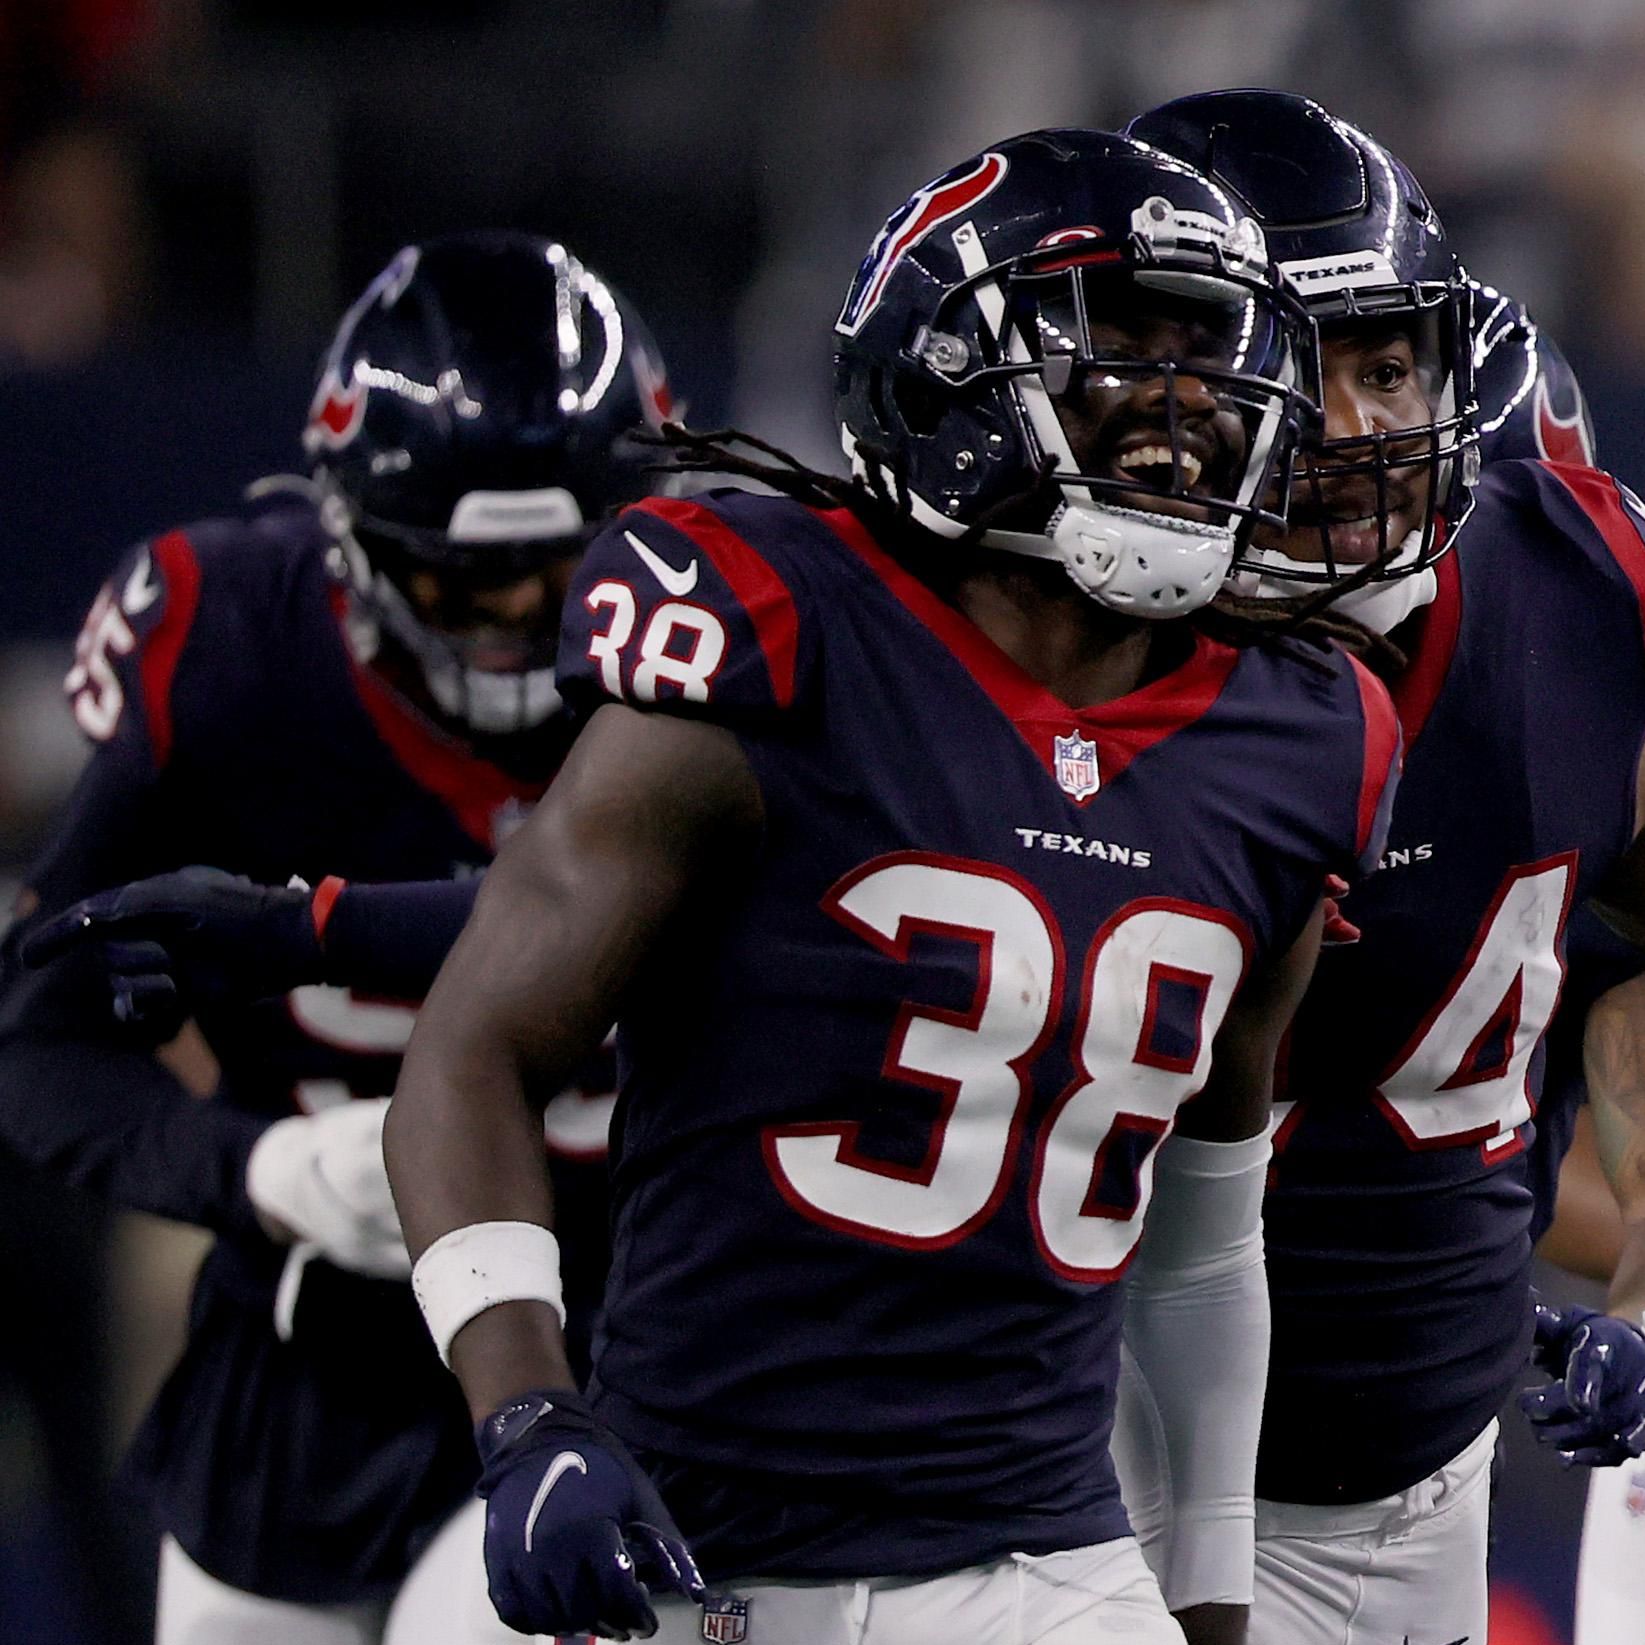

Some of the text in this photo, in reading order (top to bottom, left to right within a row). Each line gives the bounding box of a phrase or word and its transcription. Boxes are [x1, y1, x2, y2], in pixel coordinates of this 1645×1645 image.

[1288, 262, 1375, 282] TEXANS
[583, 577, 731, 704] 38
[1062, 760, 1093, 786] NFL
[1014, 827, 1152, 868] TEXANS
[762, 850, 1254, 1284] 38
[706, 1613, 744, 1641] NFL
